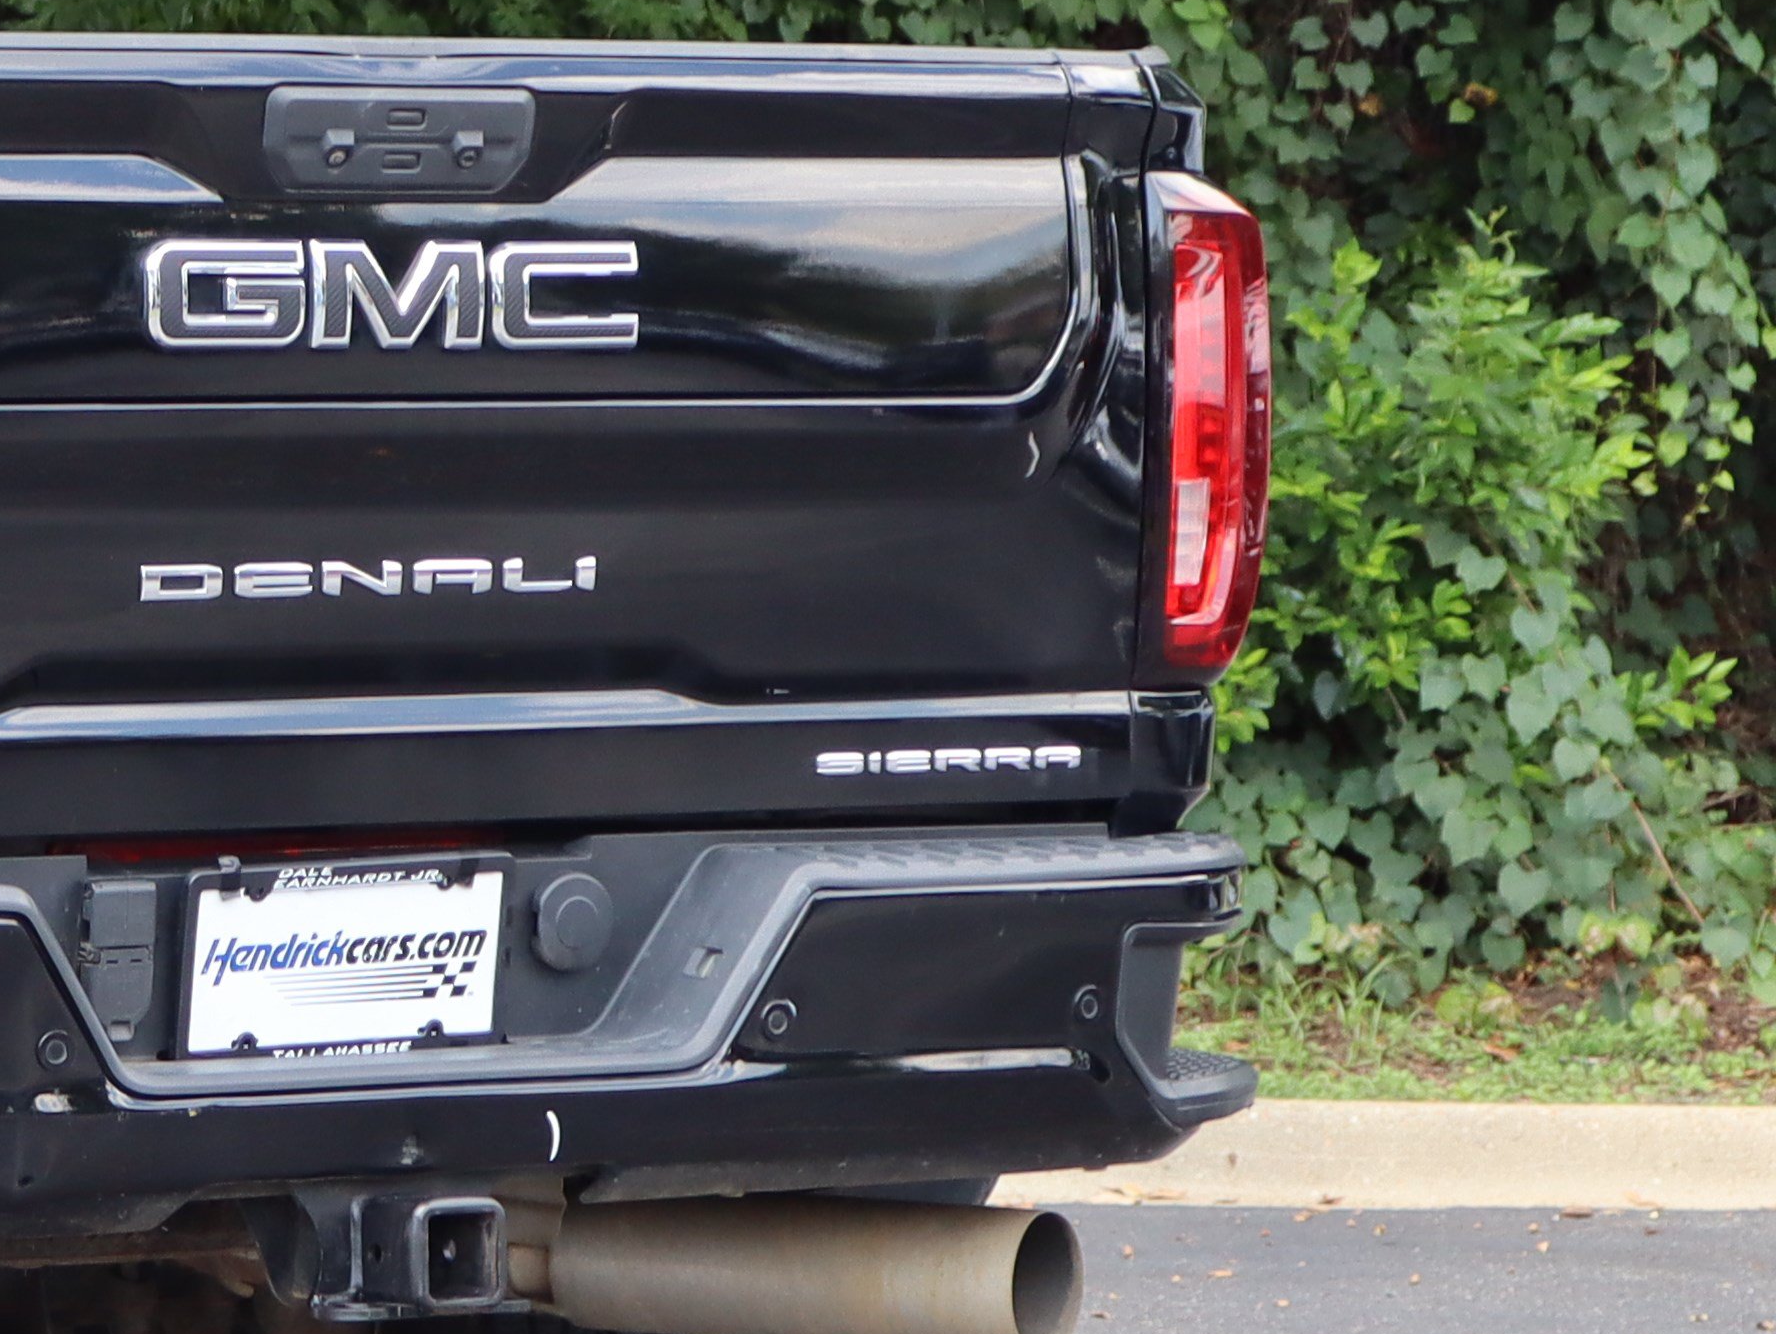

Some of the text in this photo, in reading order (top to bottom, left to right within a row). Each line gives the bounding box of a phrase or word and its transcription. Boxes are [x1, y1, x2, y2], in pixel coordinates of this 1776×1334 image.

[146, 239, 639, 349] GMC
[139, 555, 597, 602] DENALI
[816, 745, 1082, 775] SIERRA
[273, 870, 407, 890] EARNHARDT
[279, 866, 333, 879] DALE
[200, 929, 488, 987] Hendrickcars.com
